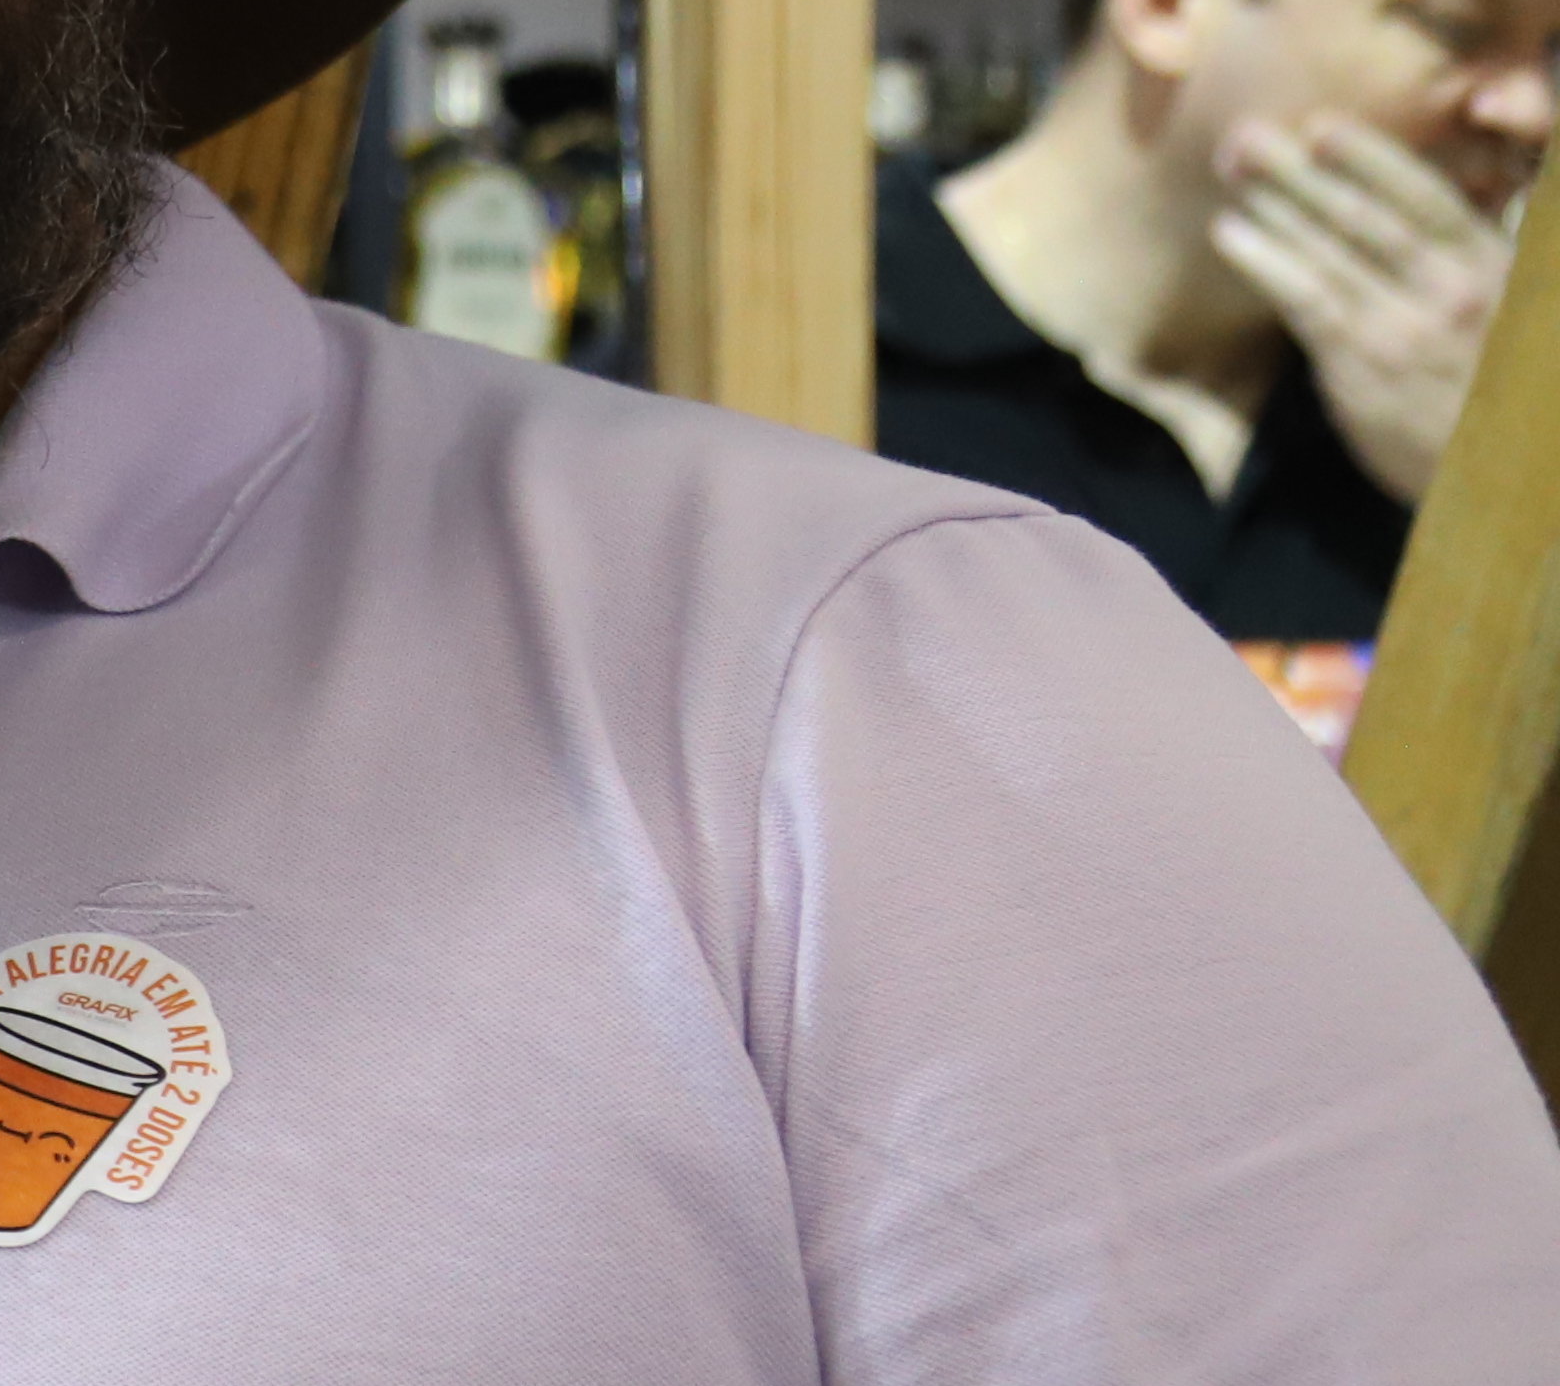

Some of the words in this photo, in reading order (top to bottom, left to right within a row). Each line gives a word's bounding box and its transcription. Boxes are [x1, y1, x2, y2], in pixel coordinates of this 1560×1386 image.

[5, 943, 148, 988] ALEGRIA
[58, 991, 140, 1022] GRAFIX
[141, 972, 197, 1021] EM
[167, 1023, 218, 1077] ATÉ
[161, 1083, 201, 1106] 2
[107, 1106, 187, 1191] DOSES
